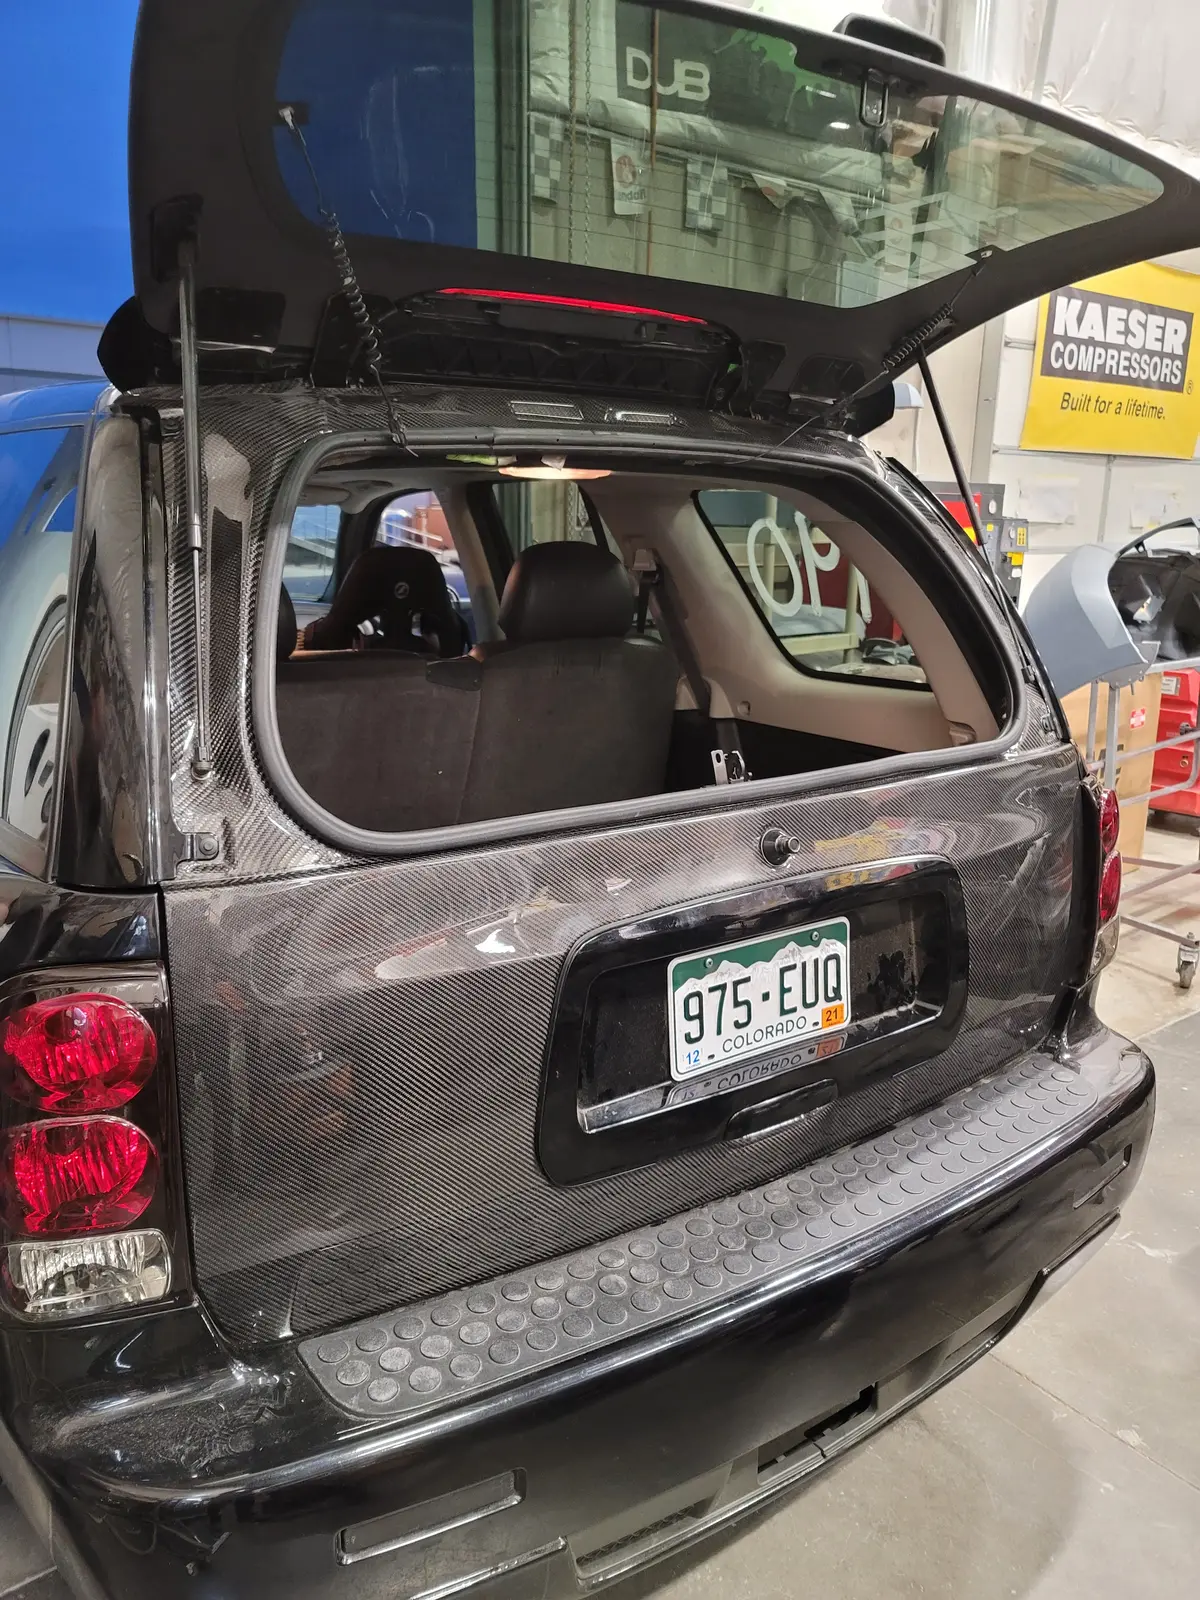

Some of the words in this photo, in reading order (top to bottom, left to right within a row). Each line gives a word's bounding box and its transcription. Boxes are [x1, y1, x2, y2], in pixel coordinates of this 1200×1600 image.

[625, 46, 711, 102] DUB
[1053, 295, 1188, 356] KAESER
[1050, 340, 1183, 385] COMPRESSORS
[1060, 391, 1092, 413] Built
[1094, 395, 1113, 414] for
[1115, 401, 1123, 415] a
[1125, 398, 1166, 420] lifetime.
[825, 1007, 838, 1022] 21
[722, 1015, 807, 1053] COLORADO
[686, 1049, 700, 1065] 12
